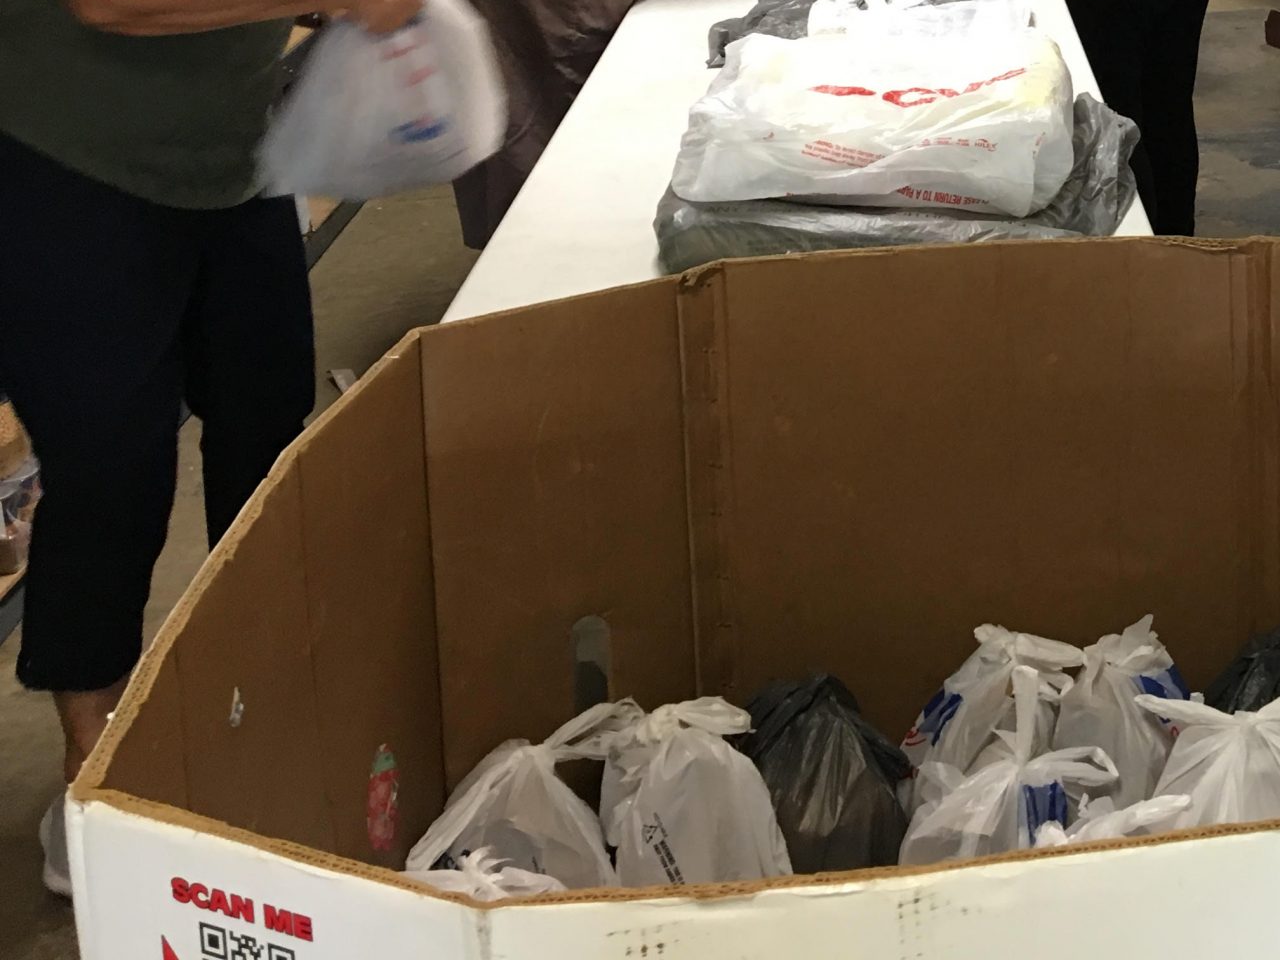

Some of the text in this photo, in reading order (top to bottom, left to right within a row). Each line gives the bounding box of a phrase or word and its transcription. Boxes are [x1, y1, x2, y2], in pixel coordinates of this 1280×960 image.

[922, 190, 933, 201] TO
[934, 191, 962, 205] RETURN
[170, 877, 314, 942] SCAN ME
